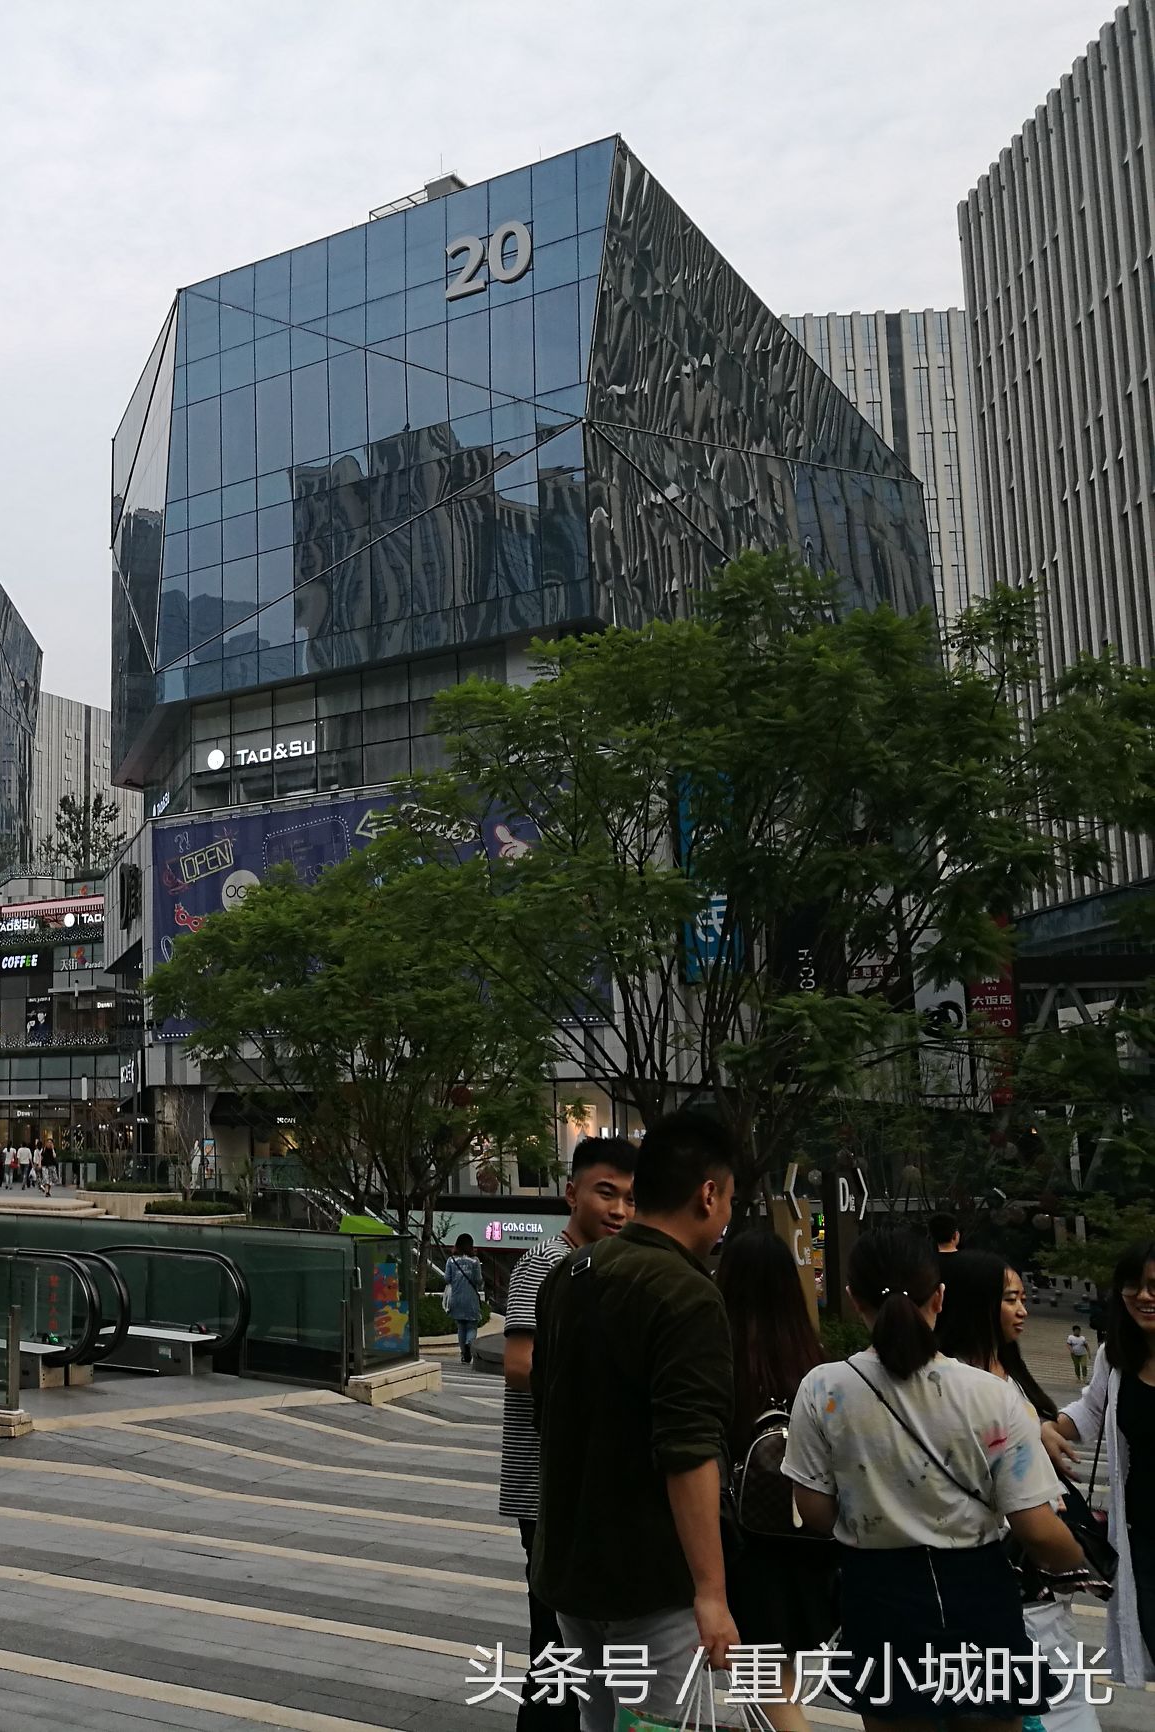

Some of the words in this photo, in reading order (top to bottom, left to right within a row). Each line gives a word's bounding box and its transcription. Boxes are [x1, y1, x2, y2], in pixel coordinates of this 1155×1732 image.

[446, 221, 531, 302] 20
[184, 842, 230, 879] OPEN
[1, 954, 39, 969] COFFEE
[972, 995, 1012, 1006] 大饭店
[502, 1222, 525, 1232] GONG
[526, 1223, 543, 1233] CHA
